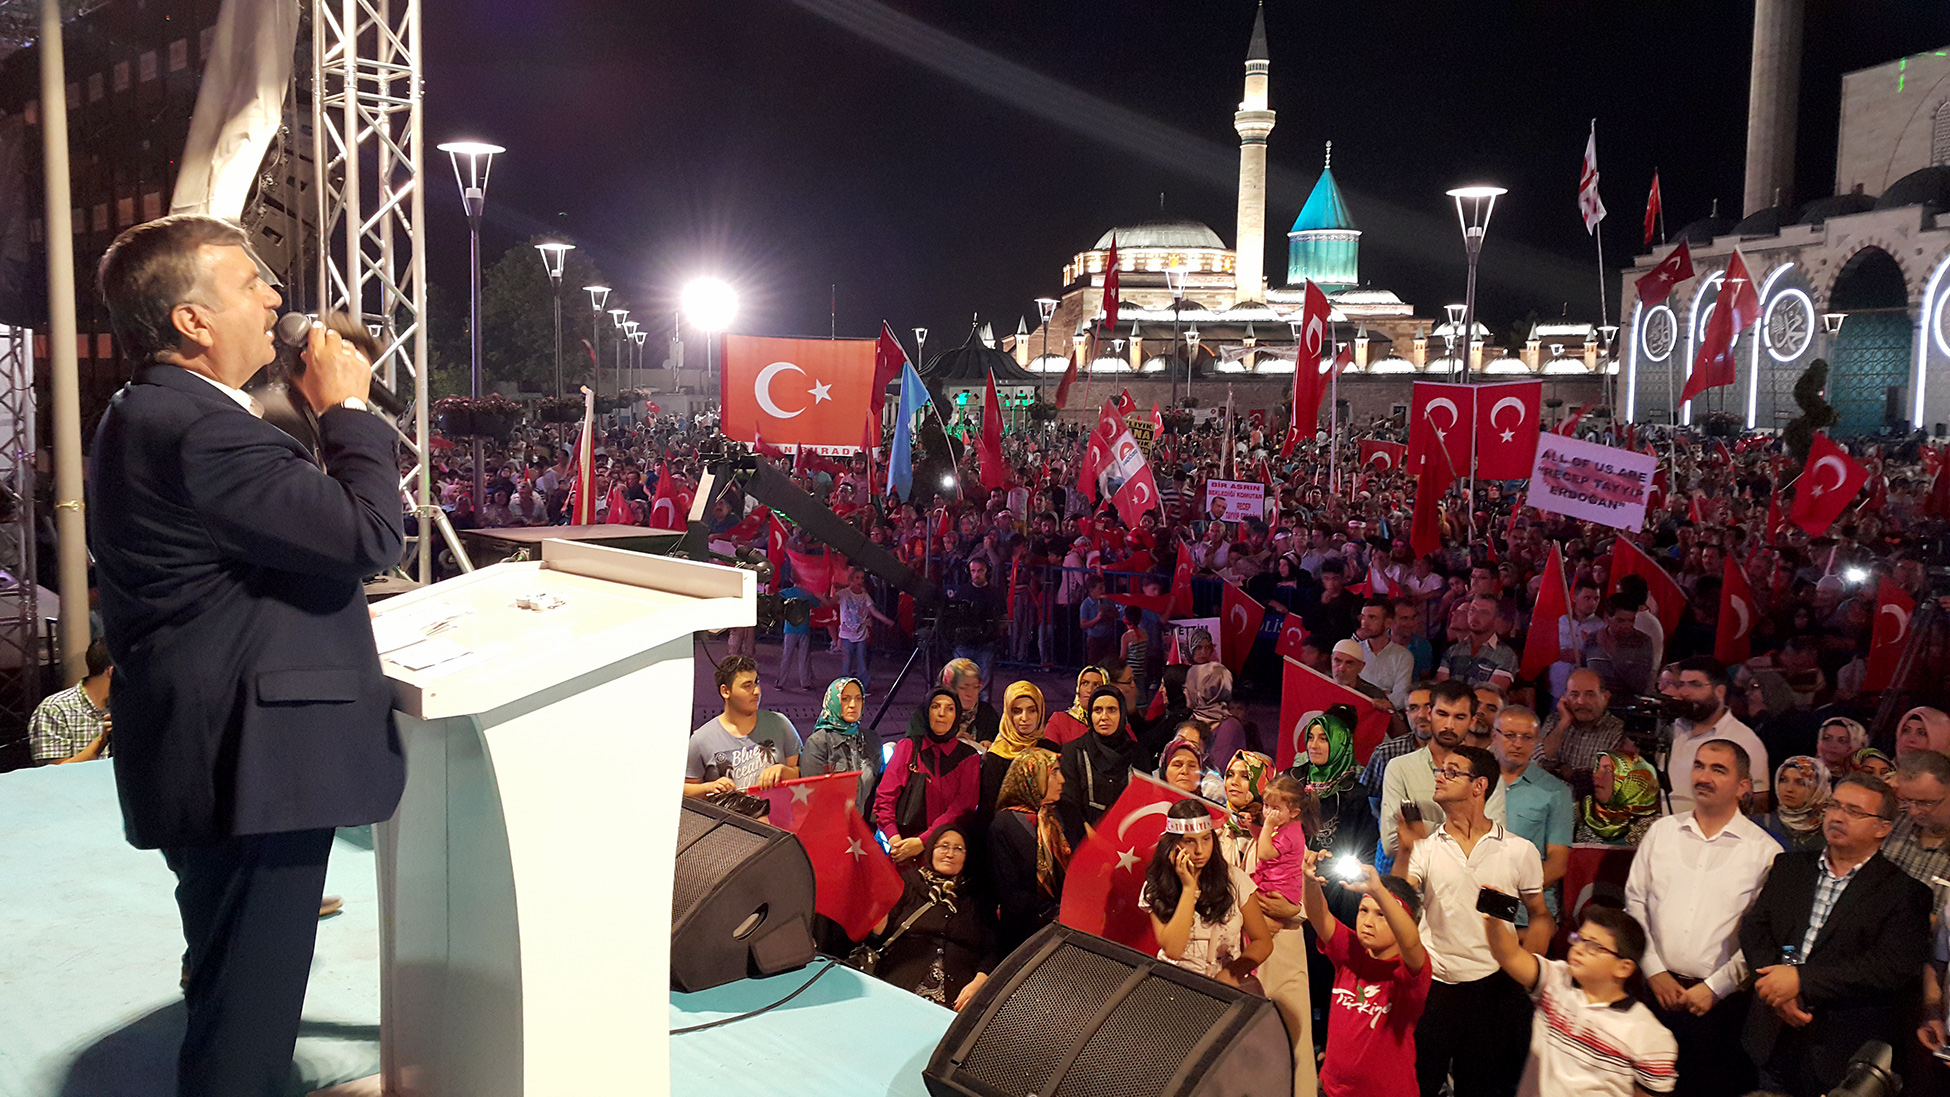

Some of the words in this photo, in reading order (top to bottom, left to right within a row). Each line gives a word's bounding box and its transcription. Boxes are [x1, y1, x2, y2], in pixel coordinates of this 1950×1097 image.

[1541, 449, 1569, 463] ALL
[1571, 457, 1591, 467] OF
[1595, 462, 1613, 475] US
[1618, 468, 1647, 483] ARE
[732, 745, 761, 767] Blue
[1332, 988, 1393, 1030] Türkiye
